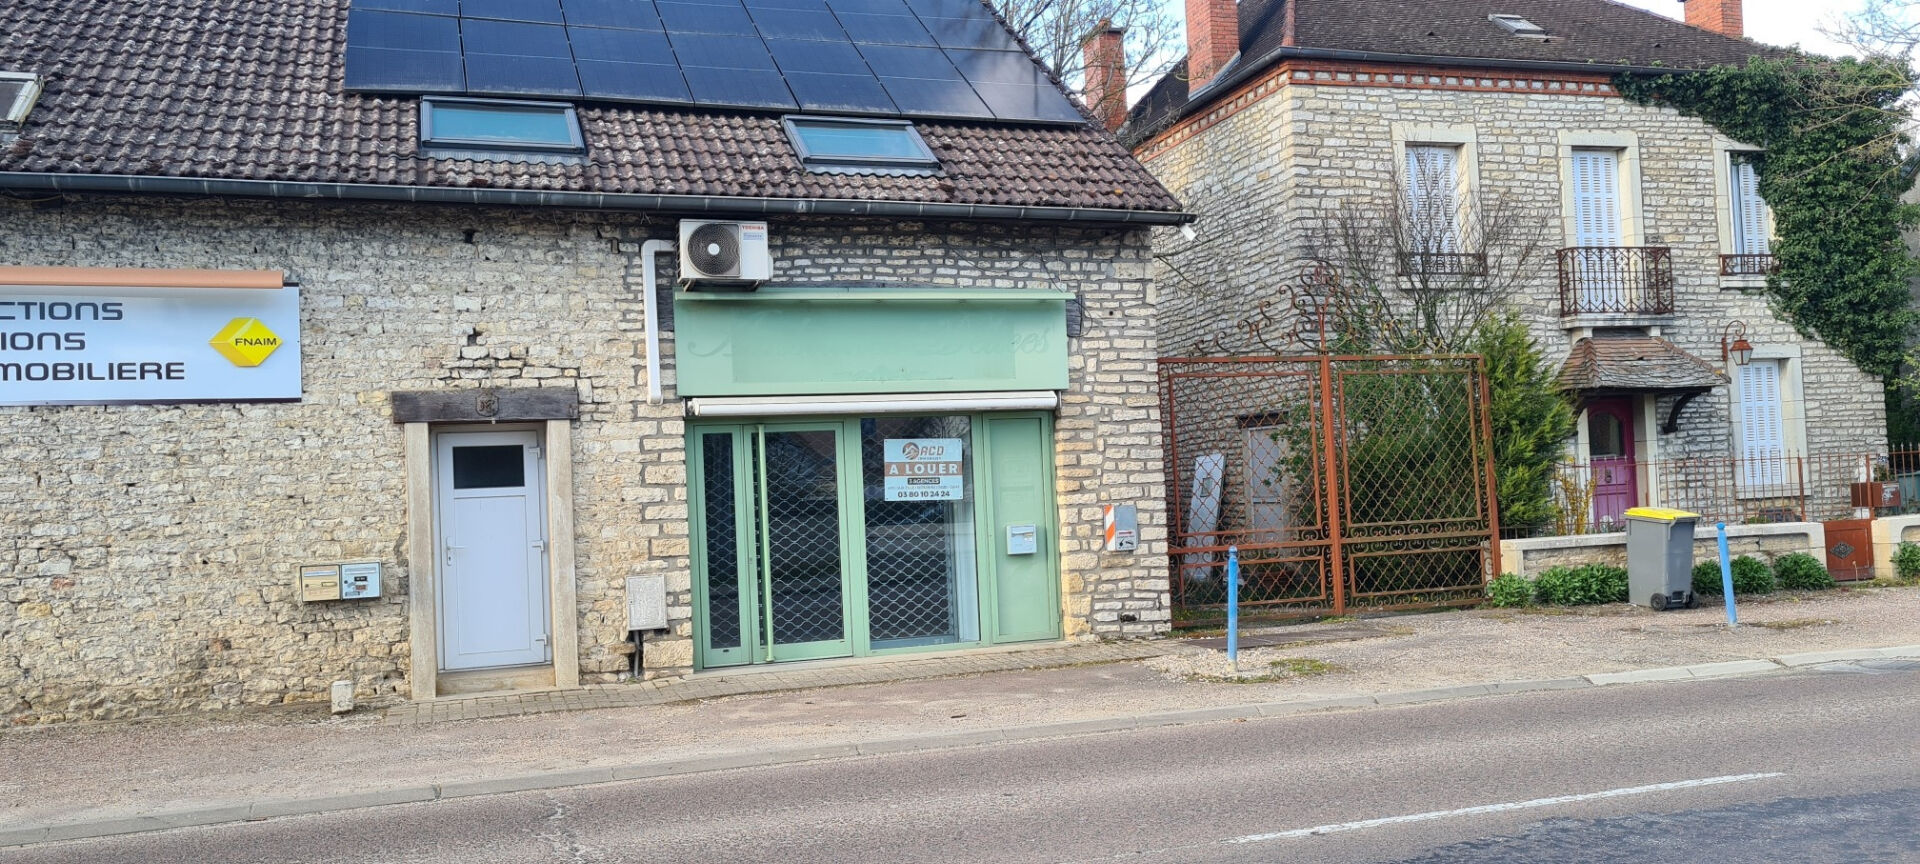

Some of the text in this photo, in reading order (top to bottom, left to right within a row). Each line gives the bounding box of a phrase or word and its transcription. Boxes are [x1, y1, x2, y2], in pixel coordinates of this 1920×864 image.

[235, 337, 277, 346] FNAIM
[889, 463, 958, 475] A LOUER
